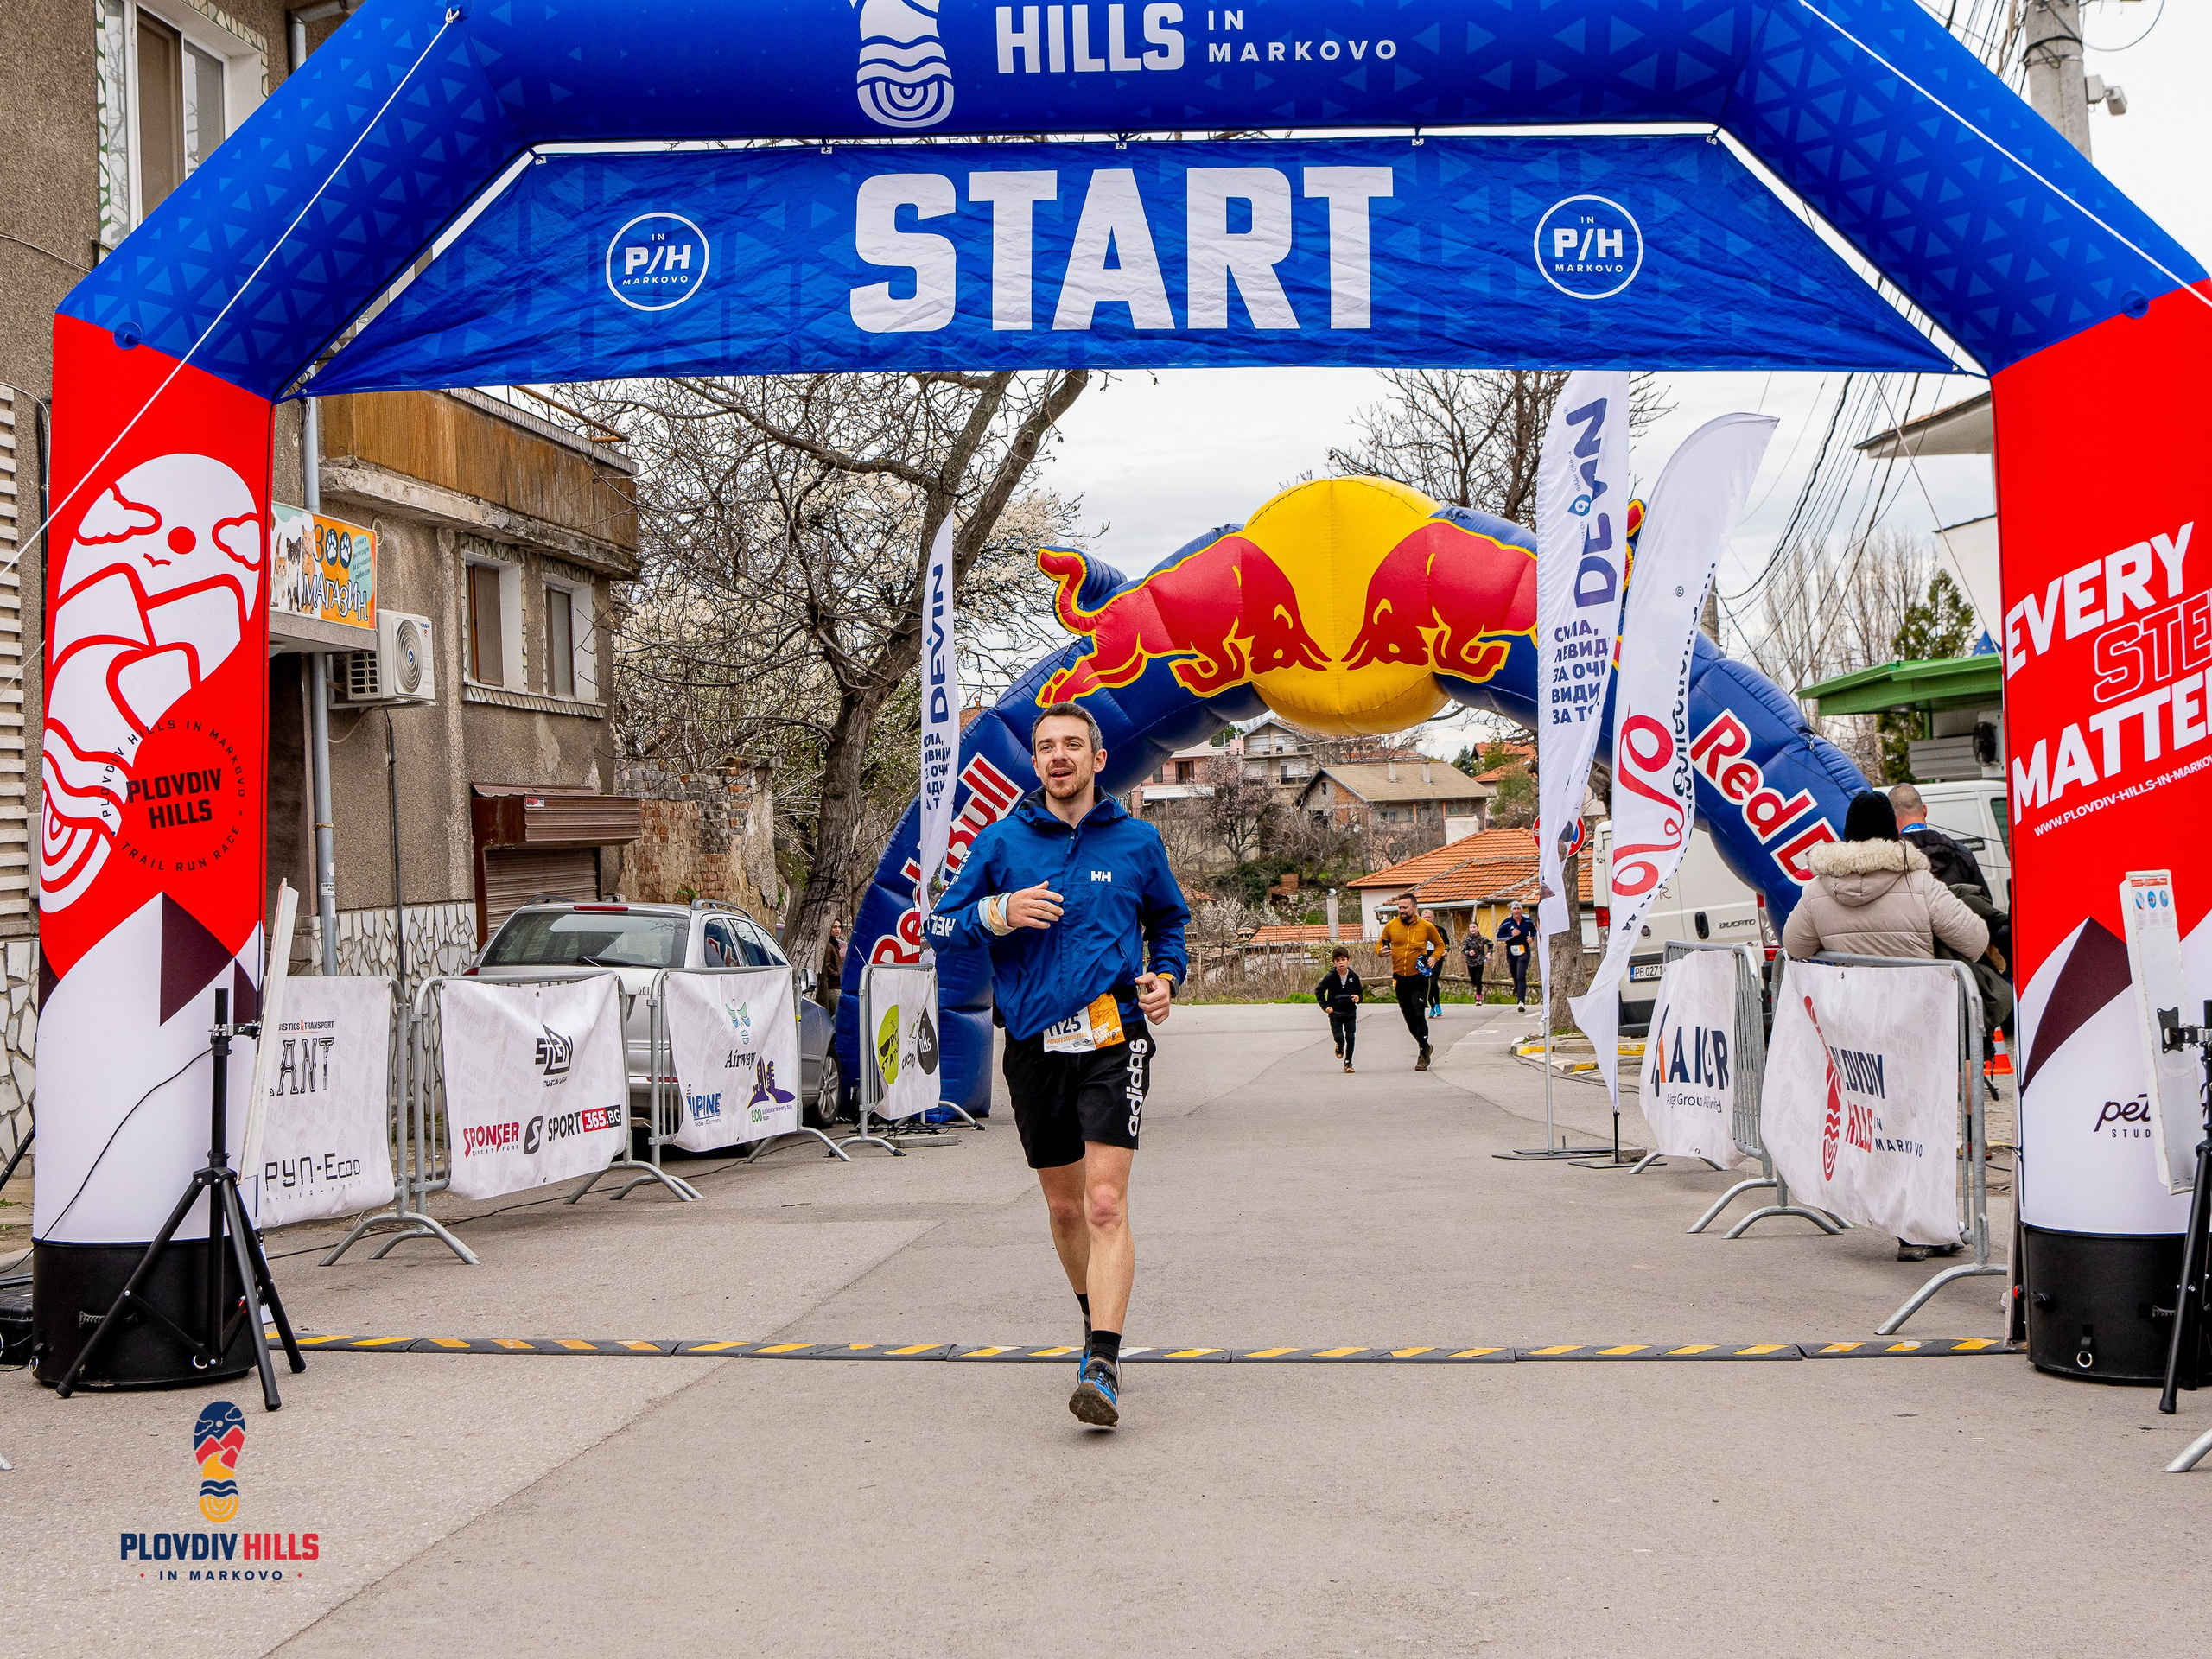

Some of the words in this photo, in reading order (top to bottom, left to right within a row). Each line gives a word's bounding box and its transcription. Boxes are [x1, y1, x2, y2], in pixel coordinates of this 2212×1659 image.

[996, 3, 1185, 73] HILLS
[1208, 10, 1244, 31] IN
[1208, 39, 1397, 62] MARKOVO
[625, 245, 691, 275] P/H
[849, 166, 1394, 334] START
[1554, 228, 1624, 261] P/H
[622, 275, 689, 286] MARKOVO
[1555, 264, 1624, 272] MARKOVO
[302, 572, 369, 621] МАГАЗИН
[2005, 521, 2195, 680] EVERY
[930, 563, 949, 724] DEVIN
[1554, 637, 1610, 664] НЕВИД
[2094, 587, 2212, 703] STE
[1551, 682, 1601, 704] ВИДИ
[1552, 708, 1573, 725] ЗА
[2012, 666, 2212, 826] MATTE
[101, 747, 124, 818] PLOVDIV
[127, 720, 176, 745] HILLS
[186, 720, 202, 732] IN
[208, 728, 245, 797] MARKOVO
[126, 767, 222, 804] PLOVDIV
[1689, 714, 1811, 839] Red
[148, 798, 213, 830] HILLS
[121, 842, 165, 871] TRAIL
[175, 857, 207, 872] RUN
[213, 826, 239, 860] RACE
[1090, 870, 1112, 883] HH
[1719, 918, 1756, 929] DUCATO
[270, 1037, 335, 1097] ANT
[1127, 1039, 1148, 1137] adidas
[463, 1122, 519, 1159] SPONSER
[1874, 1116, 1883, 1131] IN
[2111, 1128, 2152, 1138] STUD
